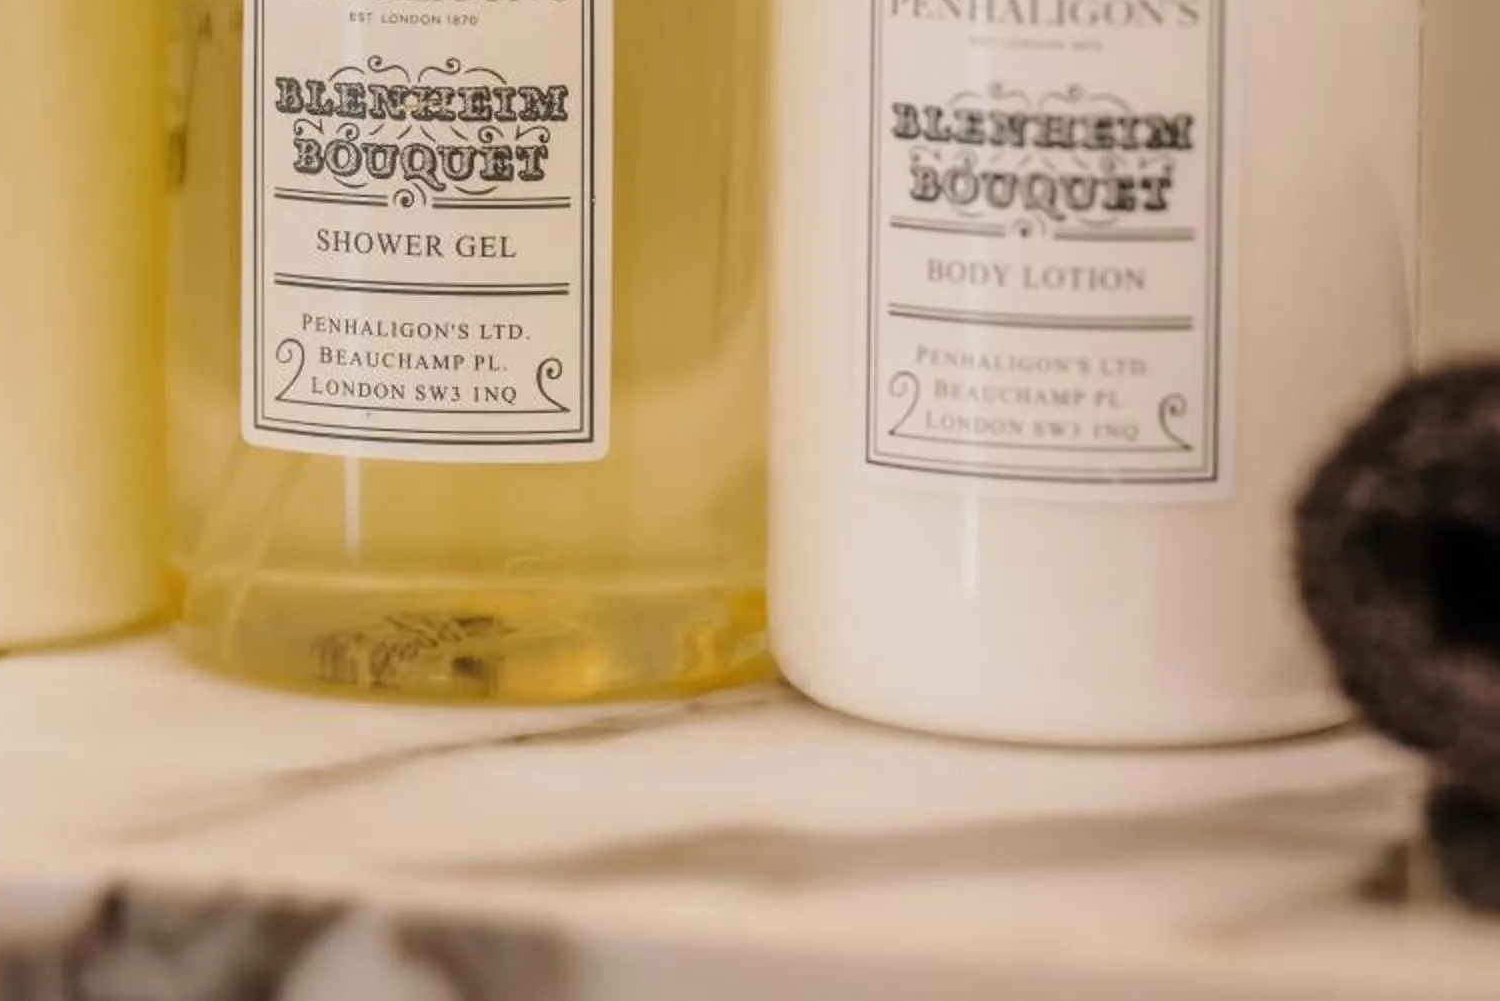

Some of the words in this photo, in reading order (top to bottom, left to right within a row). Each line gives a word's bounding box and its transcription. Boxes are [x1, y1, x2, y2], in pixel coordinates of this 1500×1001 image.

[349, 11, 373, 25] EST
[381, 12, 442, 26] LONDON
[447, 13, 478, 27] 1870
[275, 76, 569, 122] BLENHEIM
[891, 102, 1195, 150] BLENHEIM
[293, 137, 549, 191] BOUQUET
[909, 165, 1173, 222] BOUQUET
[316, 229, 445, 259] SHOWER
[455, 235, 517, 259] GEL
[927, 259, 1011, 287] BODY
[1022, 264, 1147, 292] LOTION
[302, 313, 470, 341] PENHALIGON'S
[480, 324, 531, 341] LTD.
[320, 346, 465, 372] BEAUCHAMP
[475, 355, 508, 373] PL.
[311, 377, 406, 401] LONDON
[416, 385, 462, 403] SW3
[473, 386, 517, 407] 1NQ
